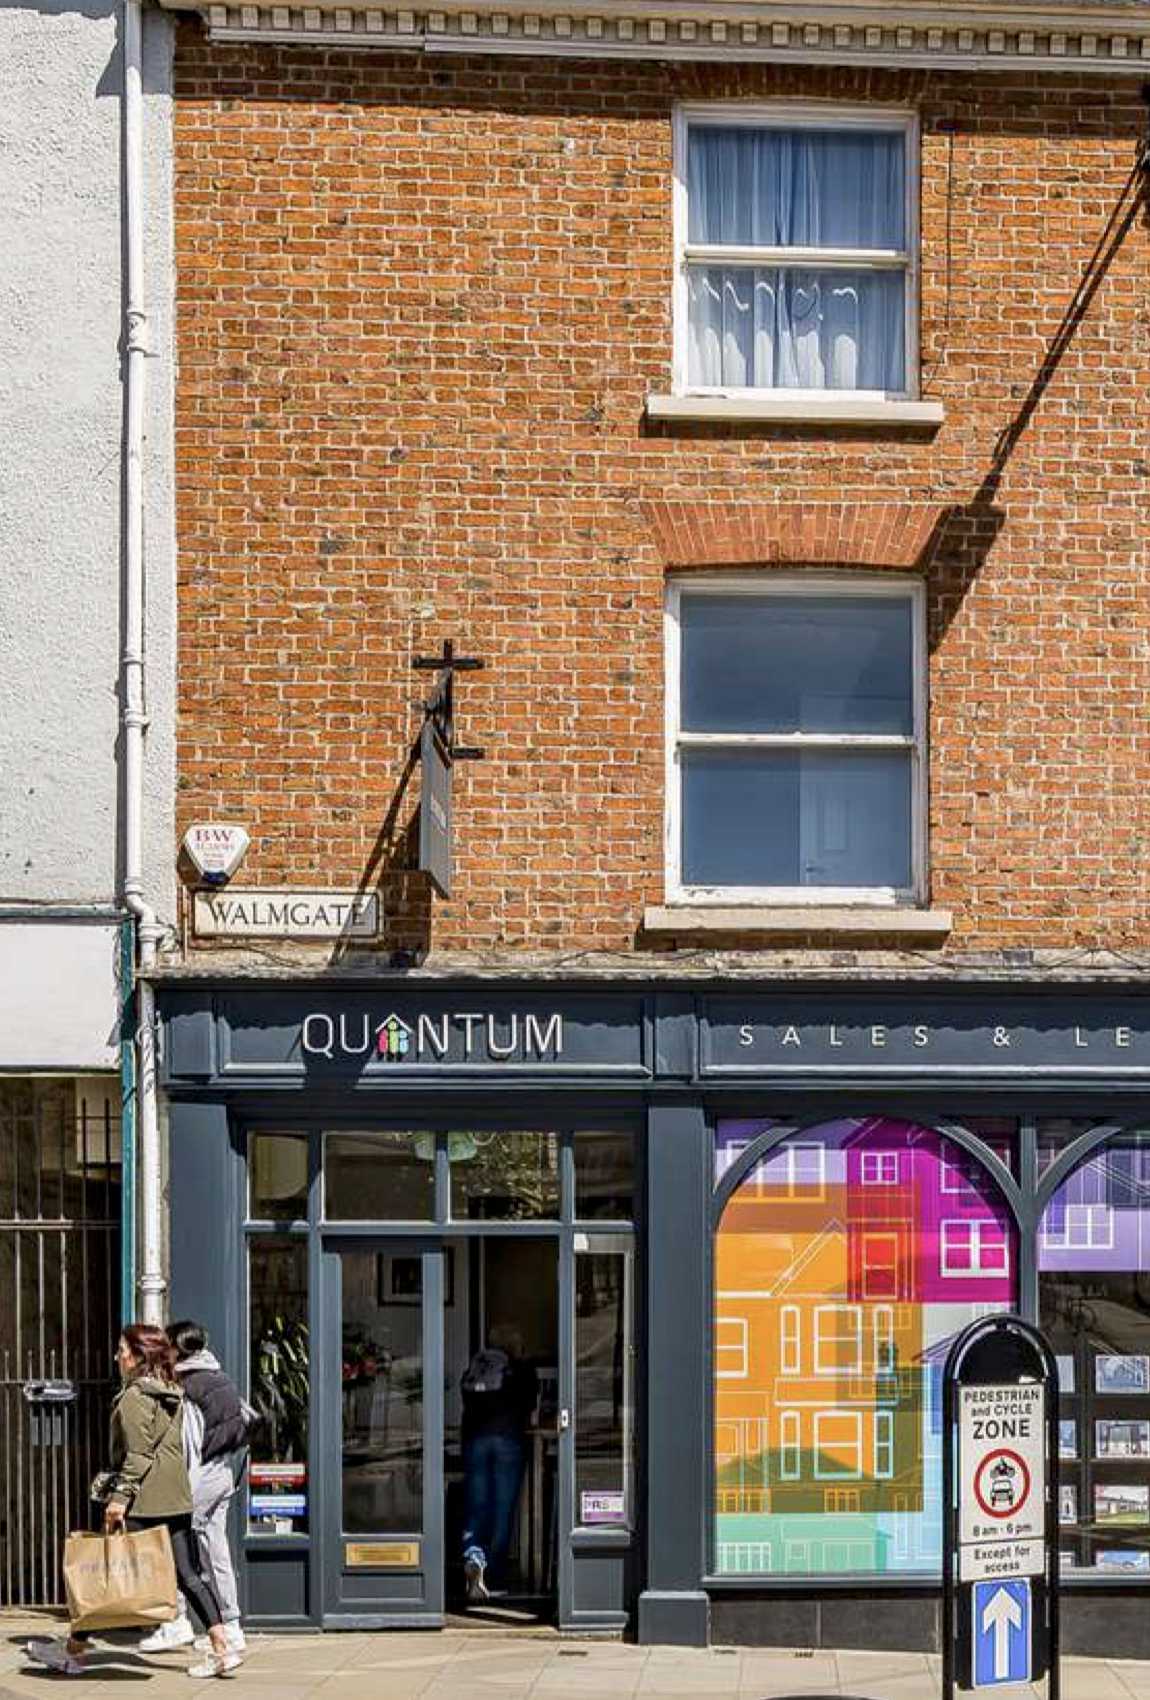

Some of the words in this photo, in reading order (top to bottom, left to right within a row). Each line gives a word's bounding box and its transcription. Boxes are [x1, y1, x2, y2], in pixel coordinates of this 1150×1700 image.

[208, 902, 368, 926] WALMGATE
[739, 1024, 929, 1046] SALES
[993, 1025, 1010, 1047] &
[965, 1389, 1039, 1403] PEDESTRIAN
[972, 1404, 991, 1417] and
[994, 1403, 1032, 1416] CYCLE
[973, 1418, 1031, 1440] ZONE
[974, 1546, 1011, 1560] Except
[1014, 1545, 1031, 1556] for
[984, 1561, 1019, 1574] access
